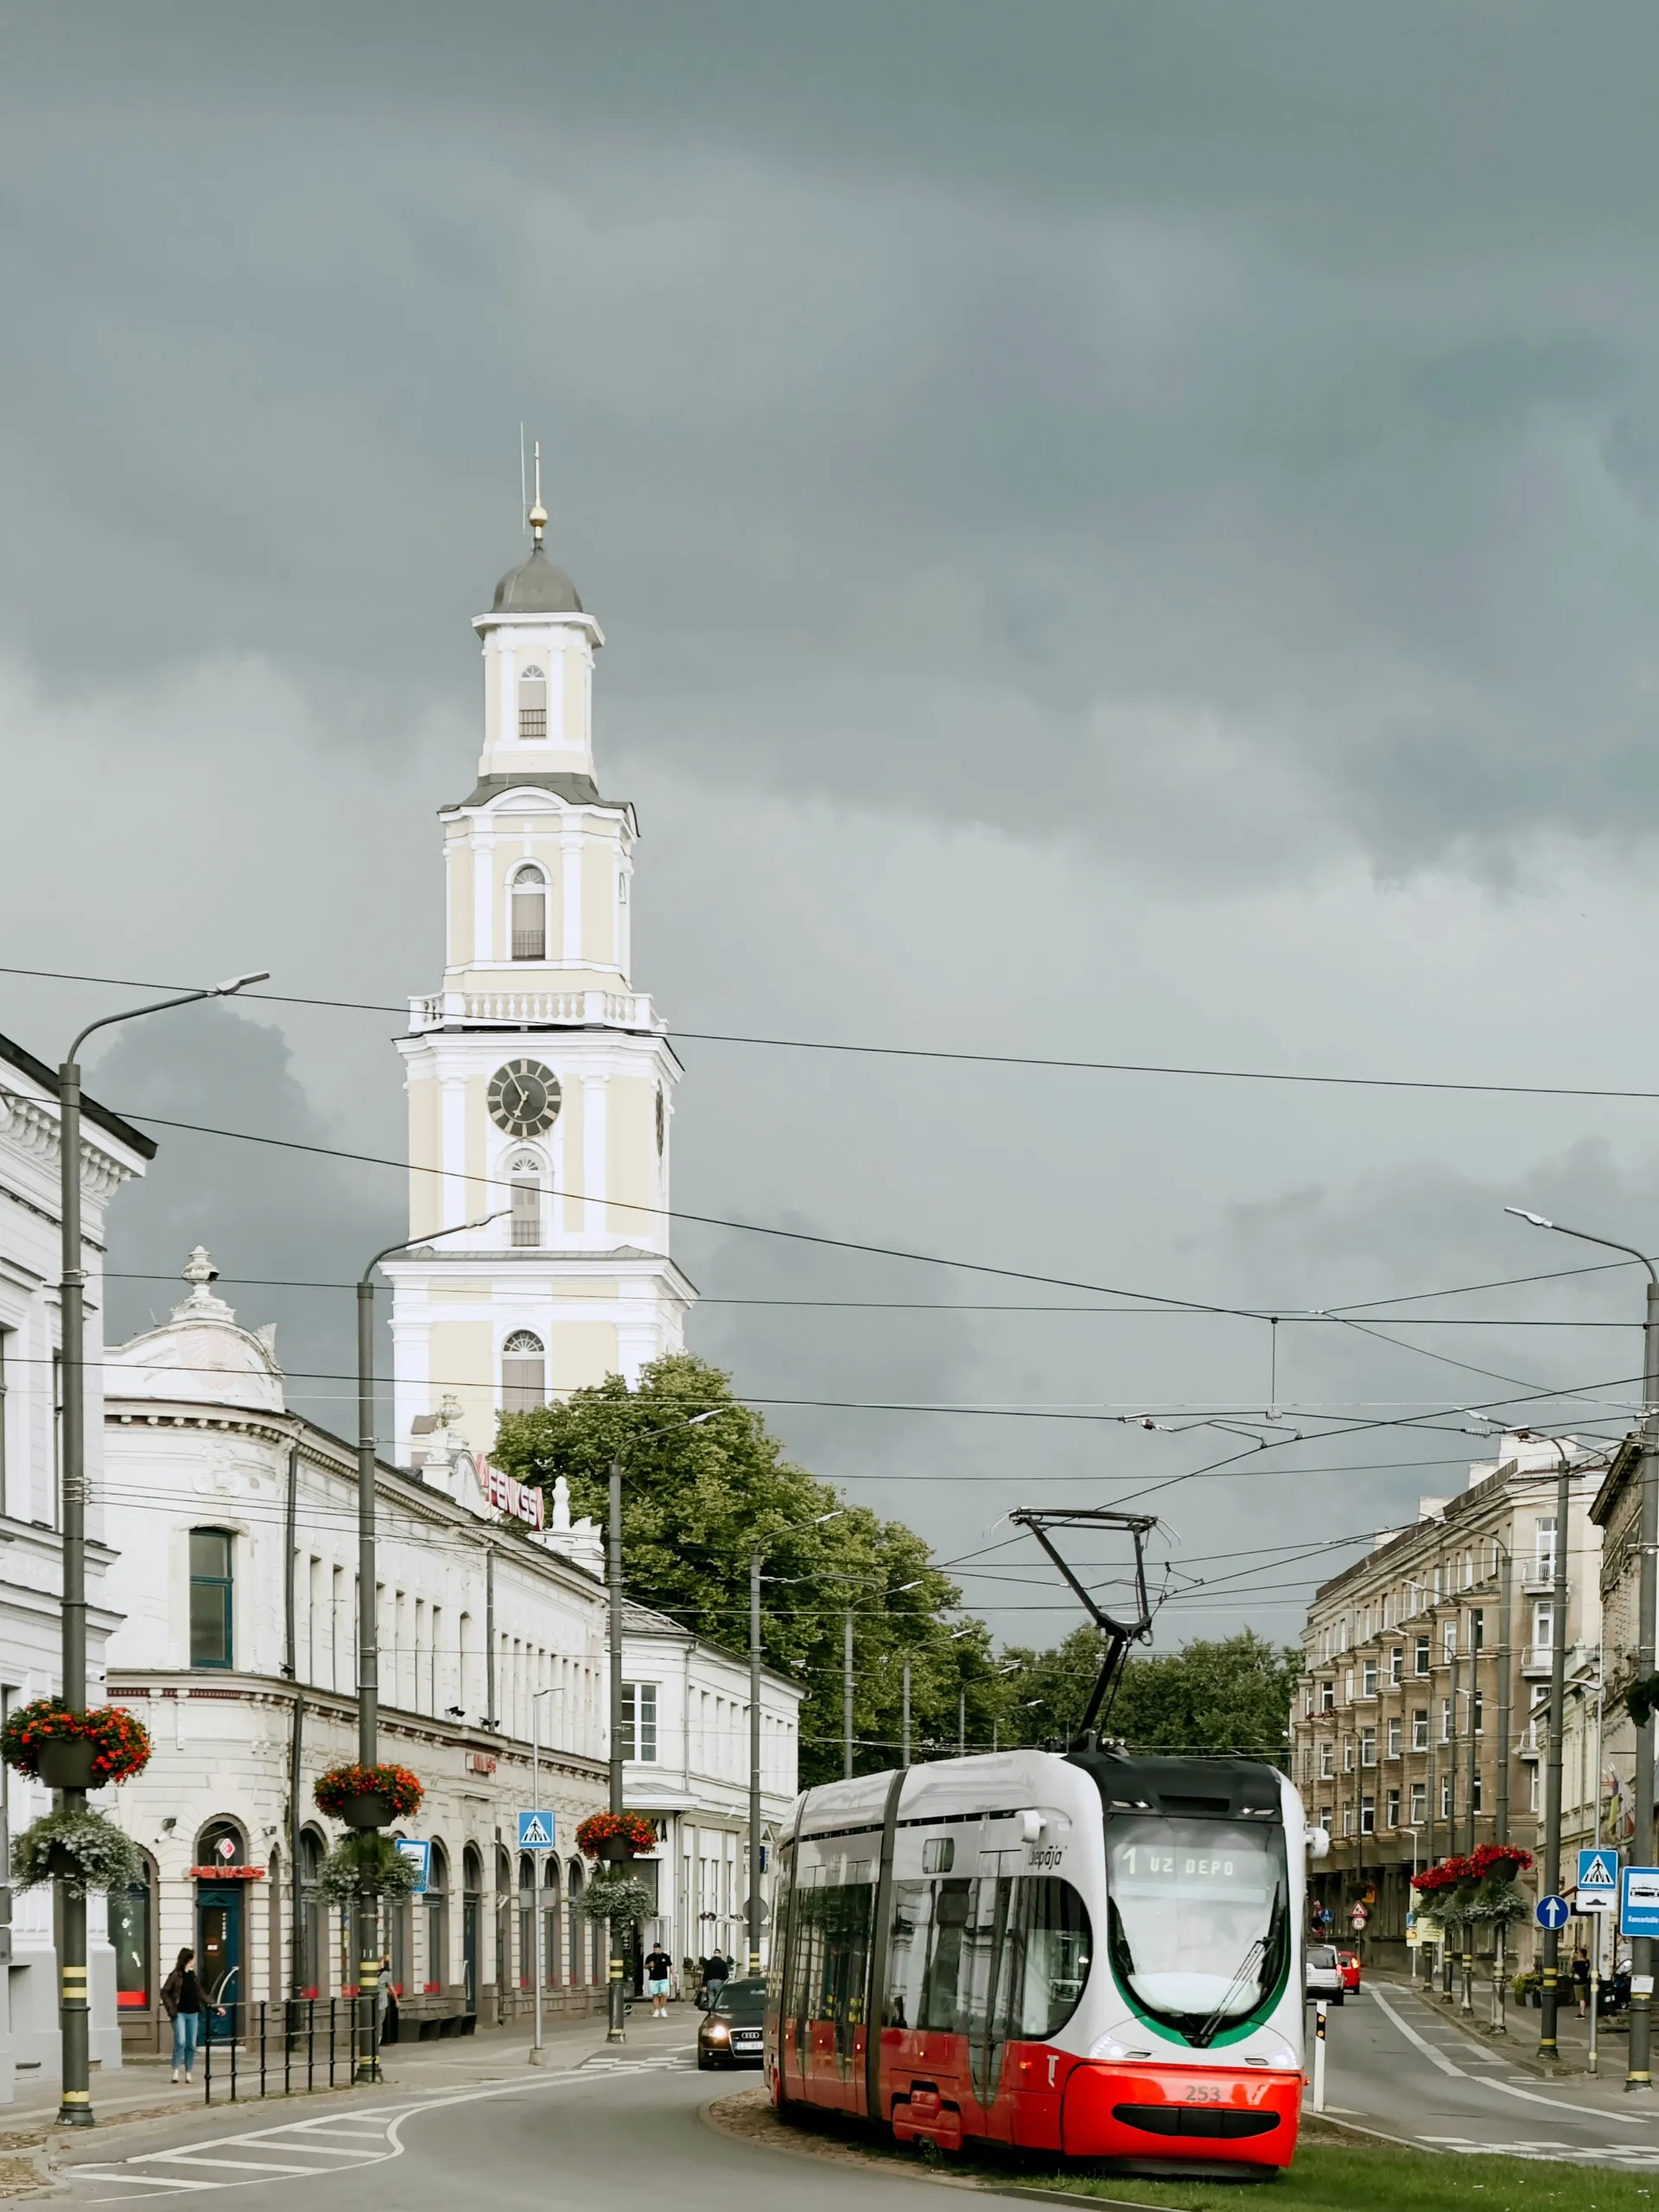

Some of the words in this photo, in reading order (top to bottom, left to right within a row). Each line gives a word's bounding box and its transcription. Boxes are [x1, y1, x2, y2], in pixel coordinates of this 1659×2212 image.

[1123, 1847, 1136, 1875] 1
[1150, 1857, 1173, 1873] UZ
[1185, 1859, 1235, 1876] DEPO
[1185, 2085, 1221, 2101] 253
